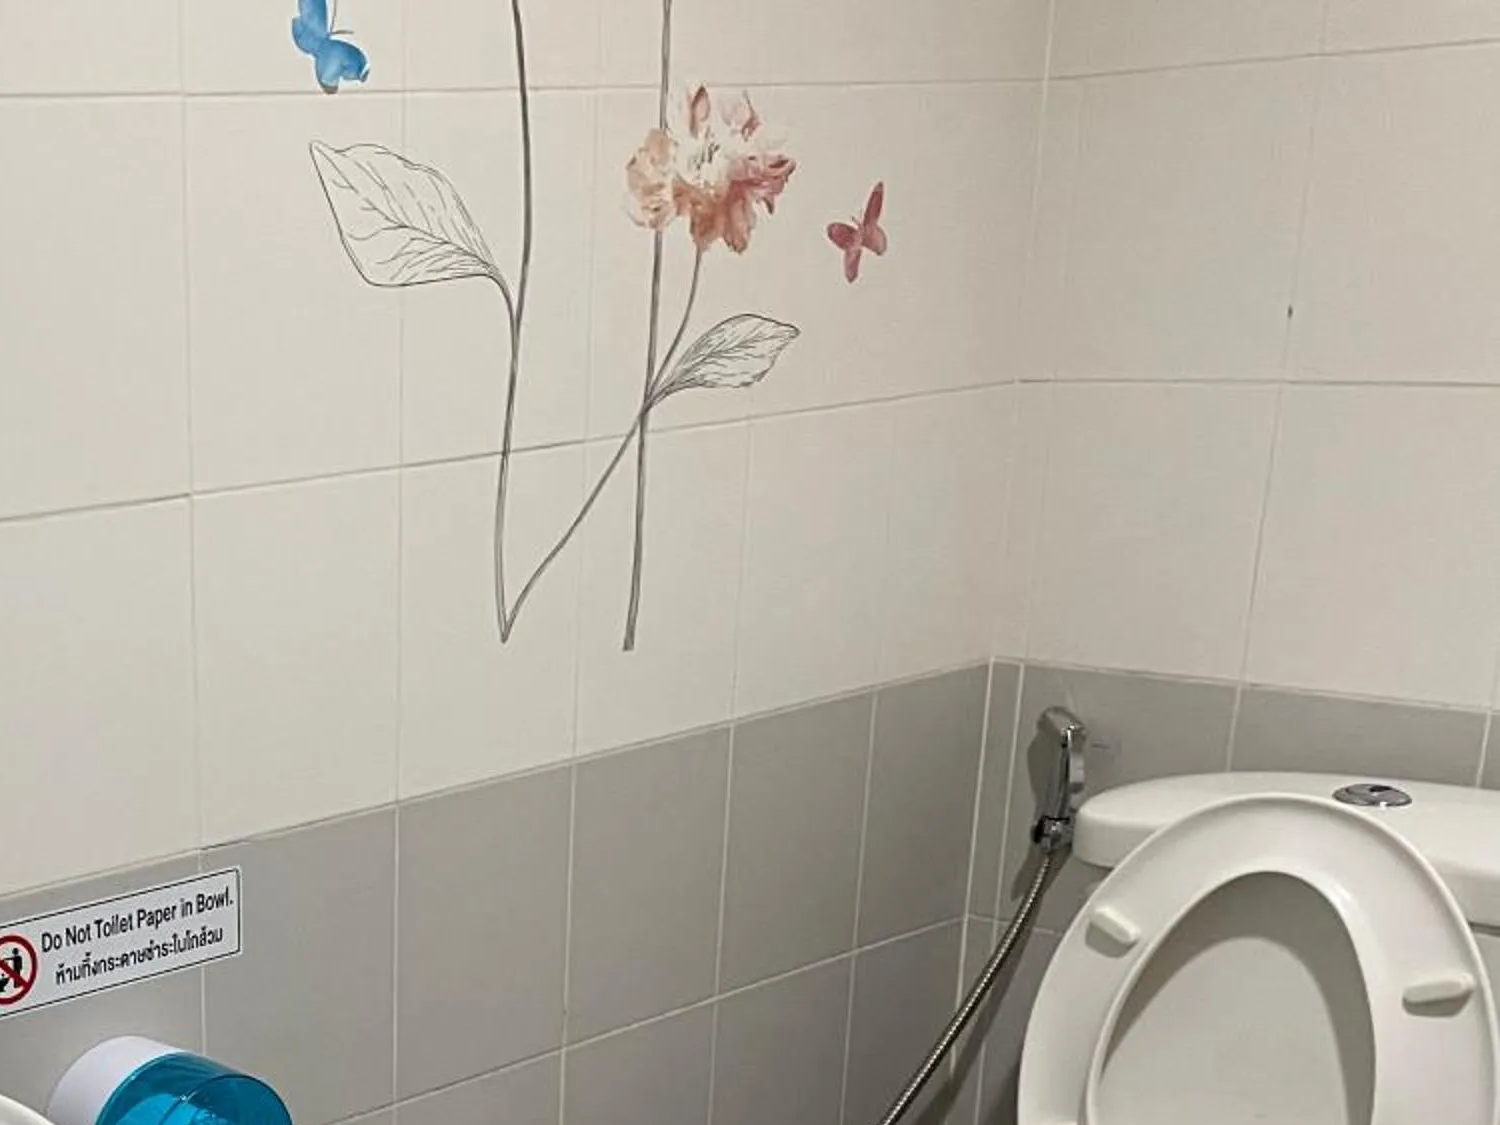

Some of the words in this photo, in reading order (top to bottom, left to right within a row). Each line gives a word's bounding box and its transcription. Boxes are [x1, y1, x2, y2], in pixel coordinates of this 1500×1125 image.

[41, 931, 63, 953] Do
[65, 924, 92, 947] Not
[94, 913, 133, 939] Toilet
[137, 905, 177, 930] Paper
[180, 898, 193, 918] in
[196, 886, 234, 913] Bowl.
